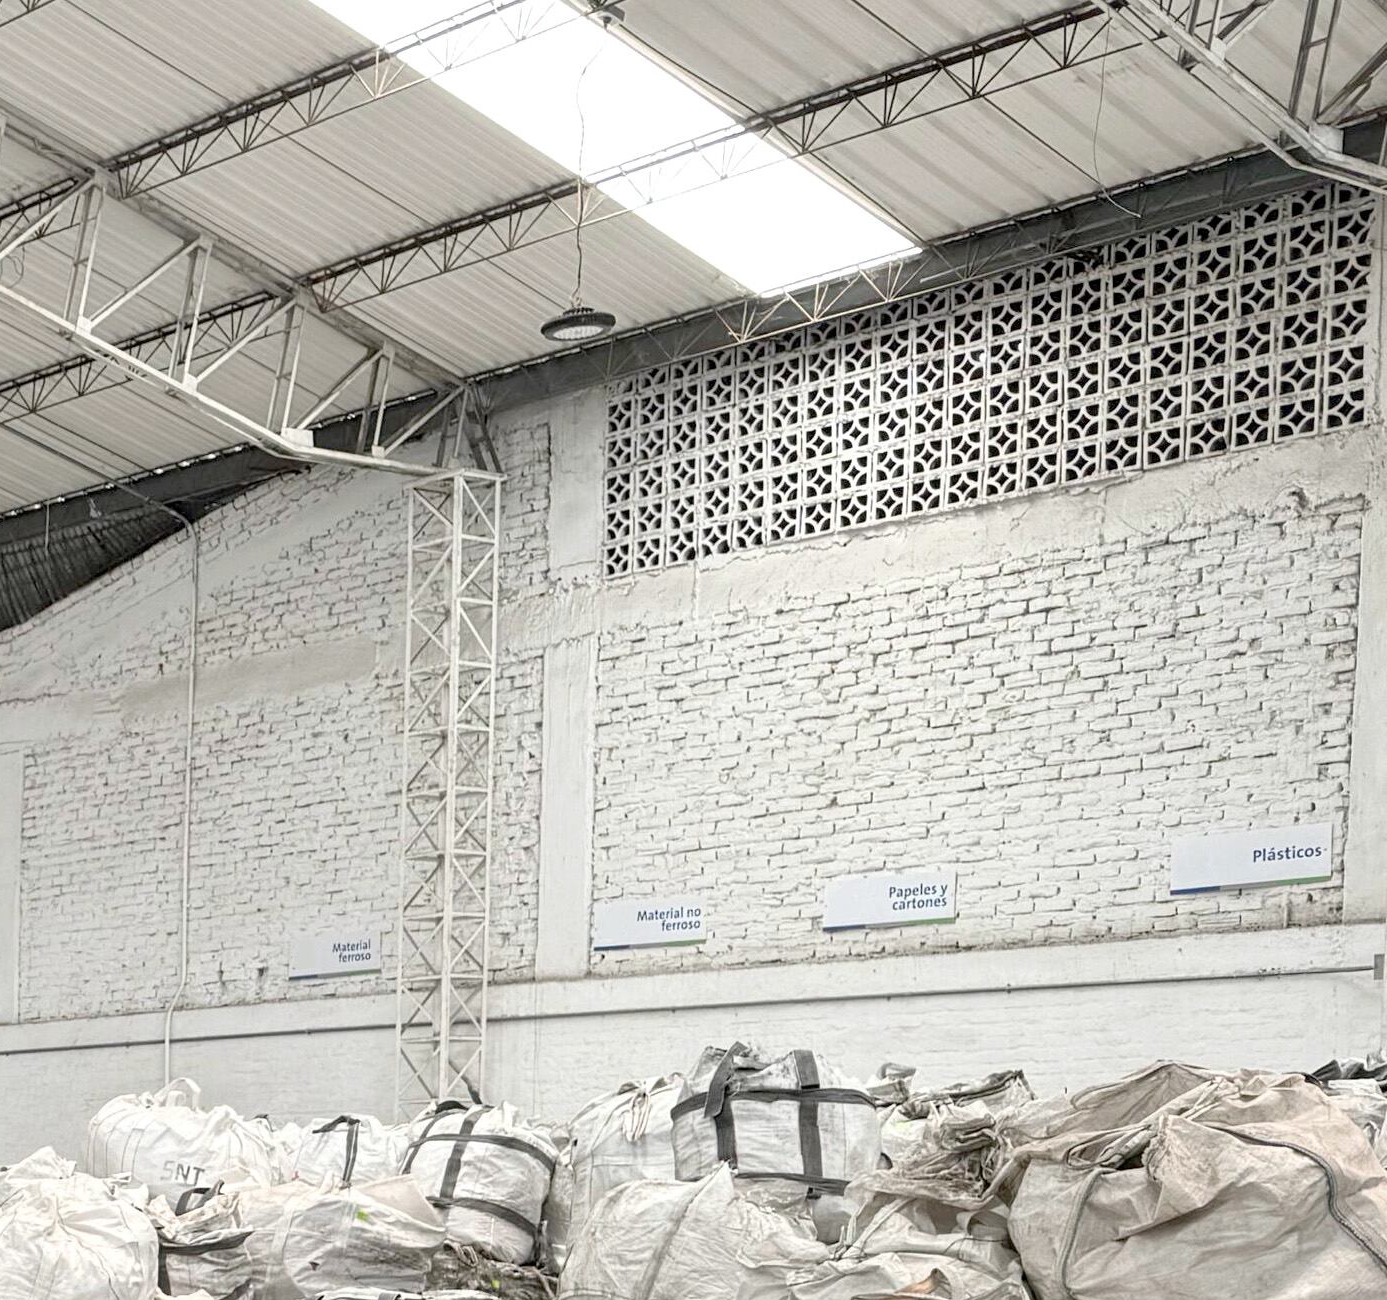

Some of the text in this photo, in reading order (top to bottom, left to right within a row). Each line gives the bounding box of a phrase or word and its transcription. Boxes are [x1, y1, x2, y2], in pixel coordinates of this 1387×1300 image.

[1252, 845, 1322, 862] Plásticos
[889, 883, 948, 900] Papeles y
[892, 897, 947, 911] cartones
[637, 906, 701, 922] Material no
[661, 920, 701, 931] ferroso
[332, 939, 371, 953] Material
[338, 952, 371, 963] ferroso
